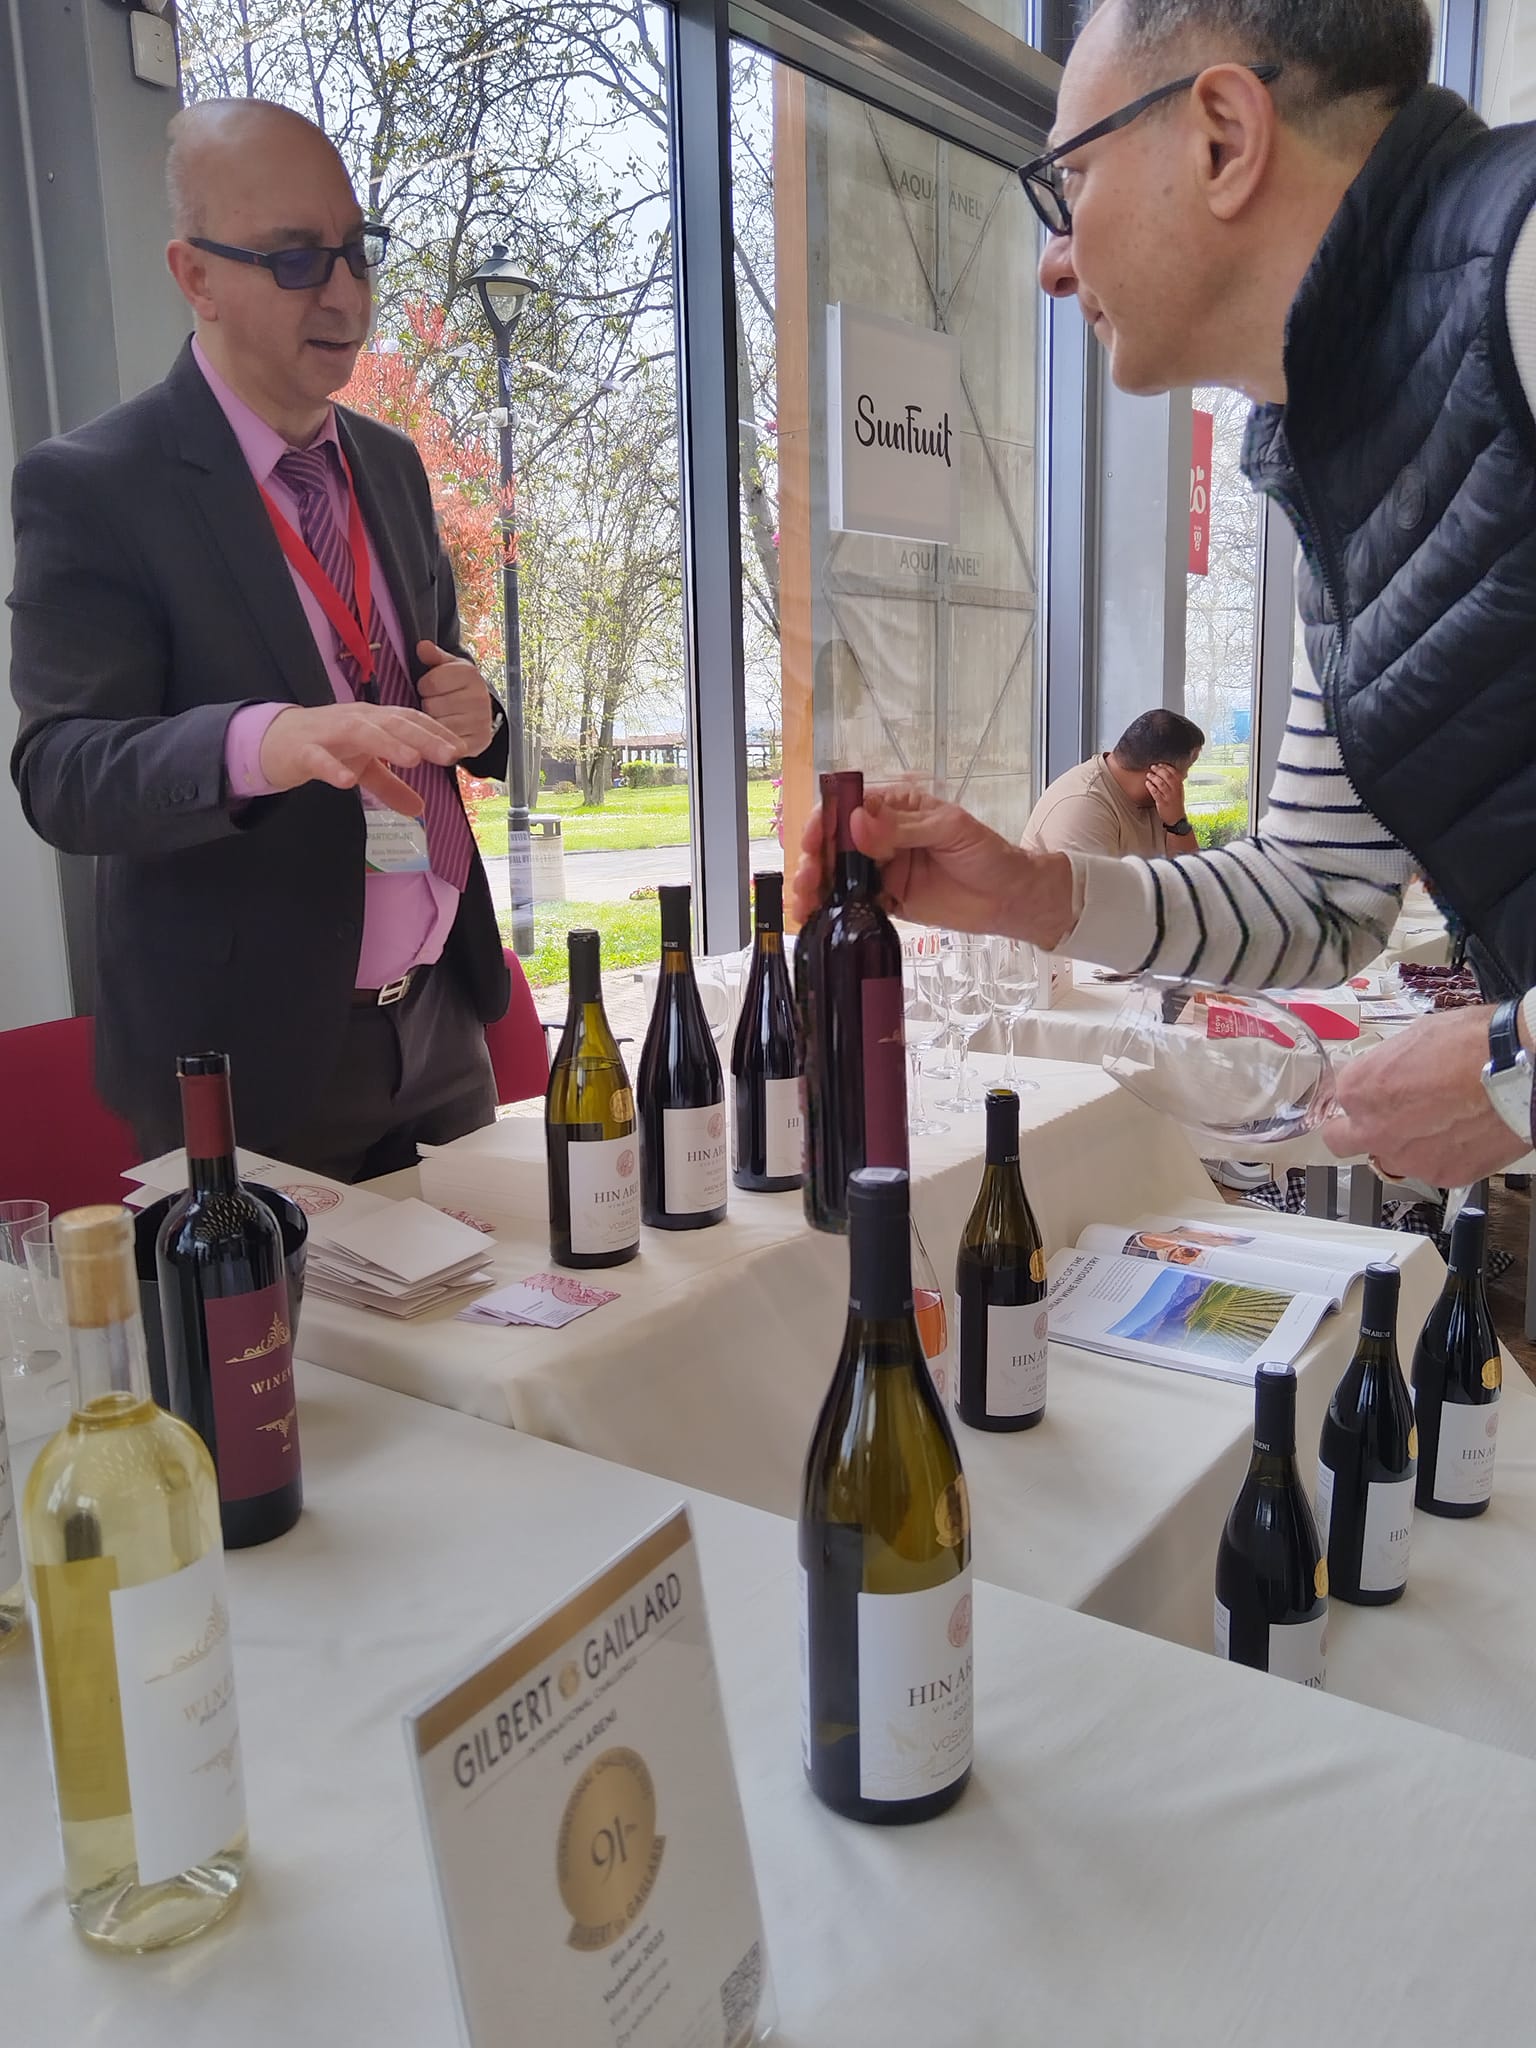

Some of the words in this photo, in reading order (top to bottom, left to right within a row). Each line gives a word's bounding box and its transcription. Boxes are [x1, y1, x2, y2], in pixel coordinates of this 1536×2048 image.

[855, 394, 953, 467] SunFruit
[687, 1149, 711, 1162] HIN
[594, 1189, 620, 1203] HIN
[1070, 1255, 1085, 1269] THE
[1076, 1256, 1100, 1285] INDUSTRY
[1011, 1351, 1036, 1367] HIN
[1461, 1447, 1486, 1460] HIN
[453, 1675, 553, 1790] GILBERT
[583, 1572, 683, 1679] GAILLARD
[907, 1674, 953, 1708] HIN
[592, 1815, 627, 1887] 91
